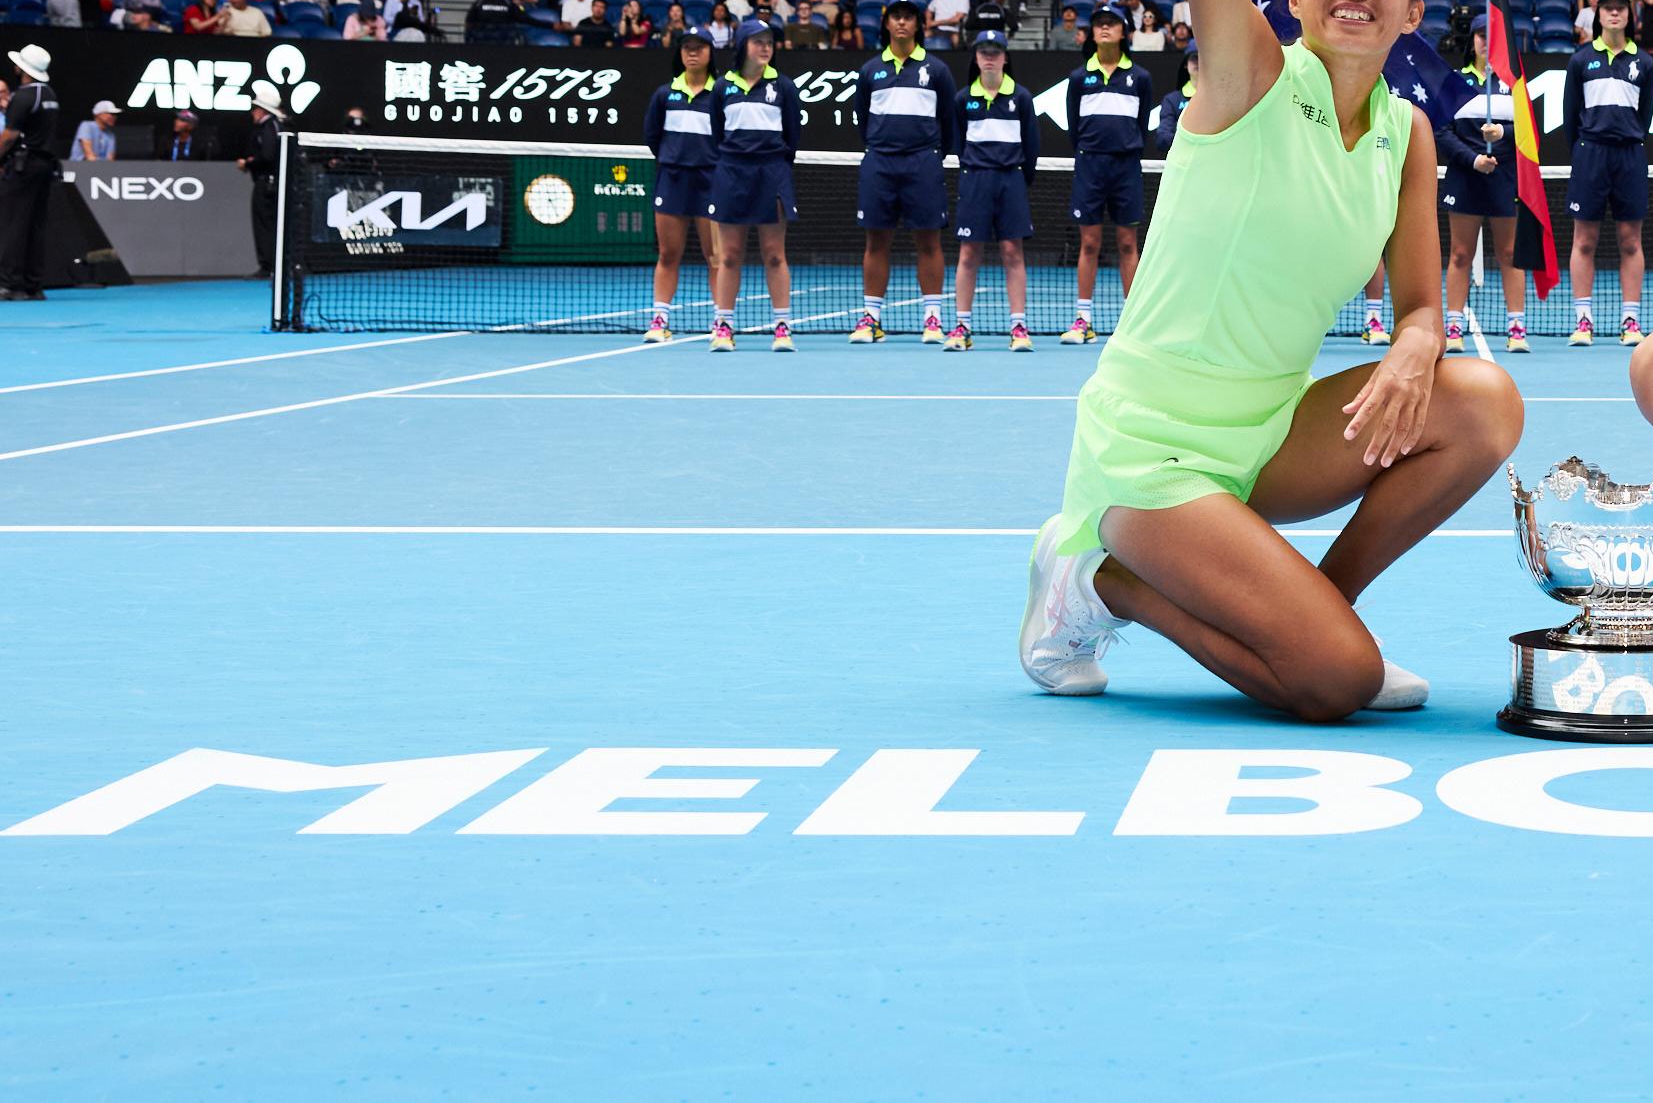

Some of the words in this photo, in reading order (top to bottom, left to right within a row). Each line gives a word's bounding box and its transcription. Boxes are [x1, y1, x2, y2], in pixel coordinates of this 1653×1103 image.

[127, 58, 252, 111] ANZ
[384, 104, 522, 123] GUOJIAO
[549, 107, 618, 125] 1573
[90, 176, 205, 201] NEXO
